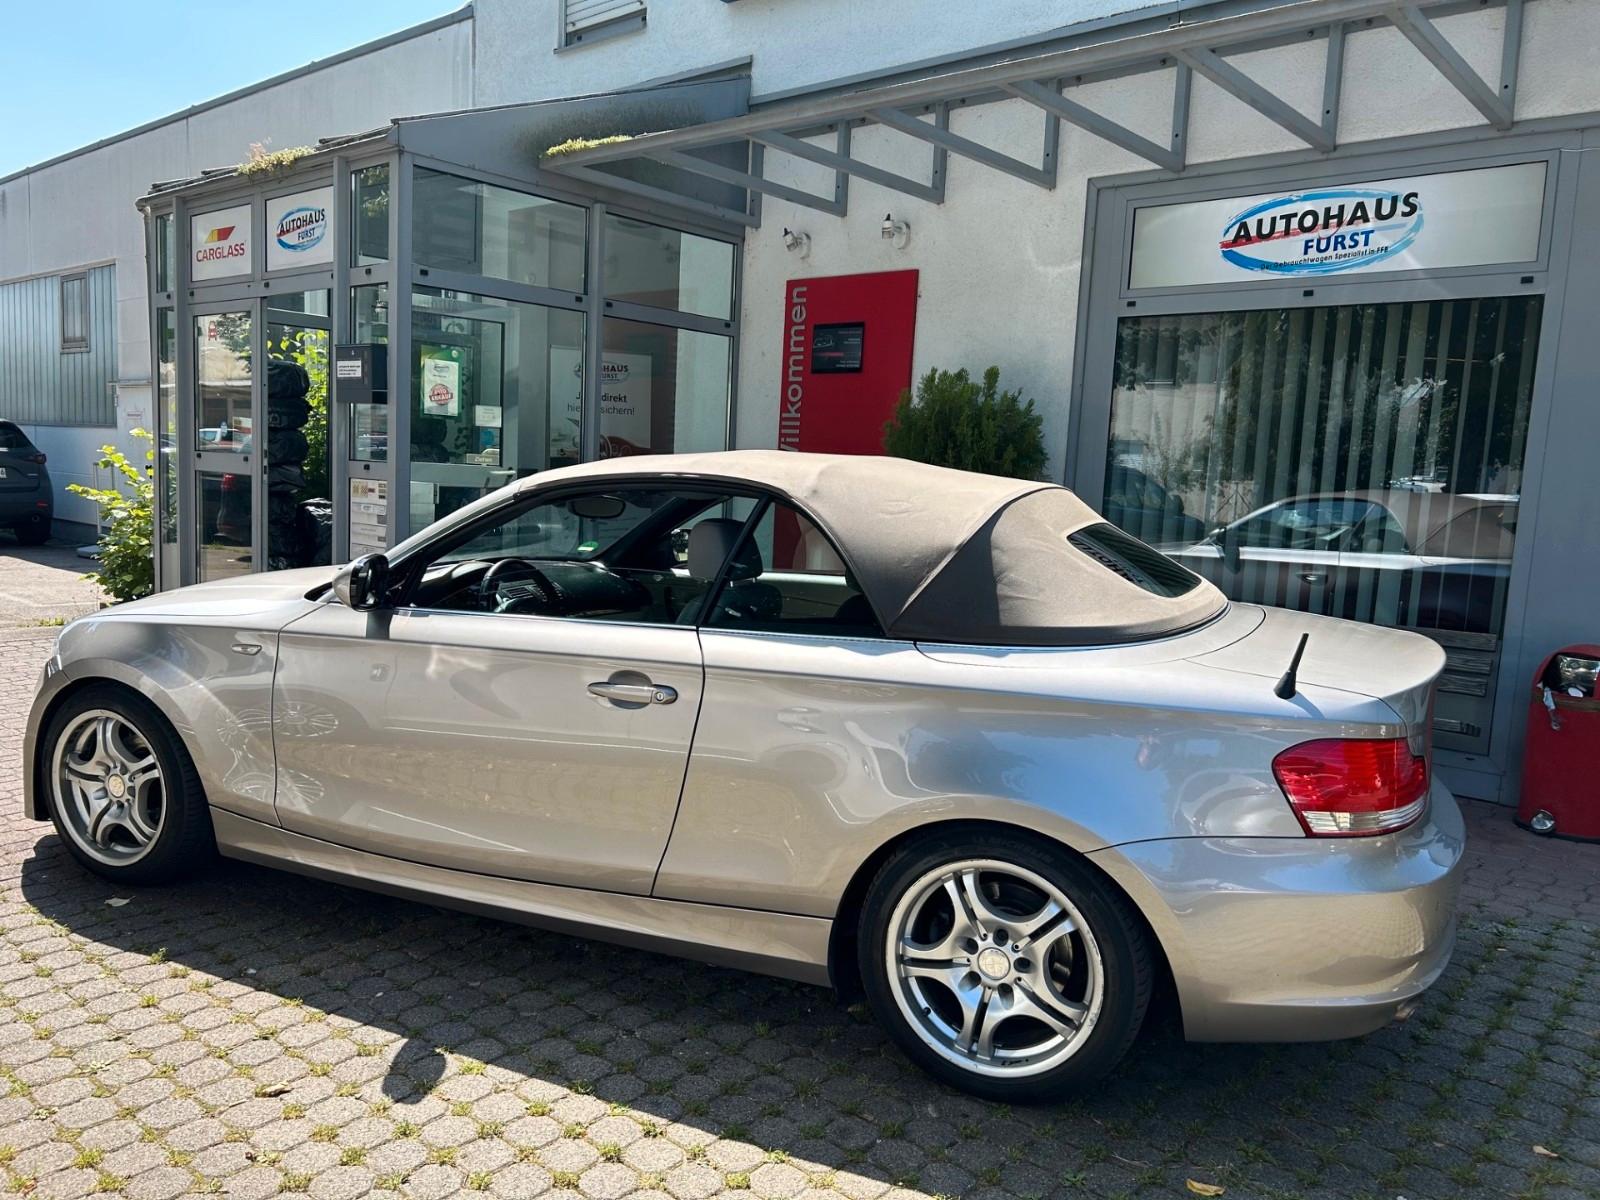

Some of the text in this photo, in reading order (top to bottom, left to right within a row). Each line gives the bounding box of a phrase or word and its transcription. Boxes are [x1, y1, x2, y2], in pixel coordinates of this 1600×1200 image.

[279, 208, 325, 235] AUTOHAUS
[1232, 192, 1419, 243] AUTOHAUS
[196, 242, 245, 262] CARGLASS
[1273, 255, 1333, 268] Gebrauchtwagen
[601, 392, 627, 403] direkt
[567, 403, 635, 416] hie sichern!
